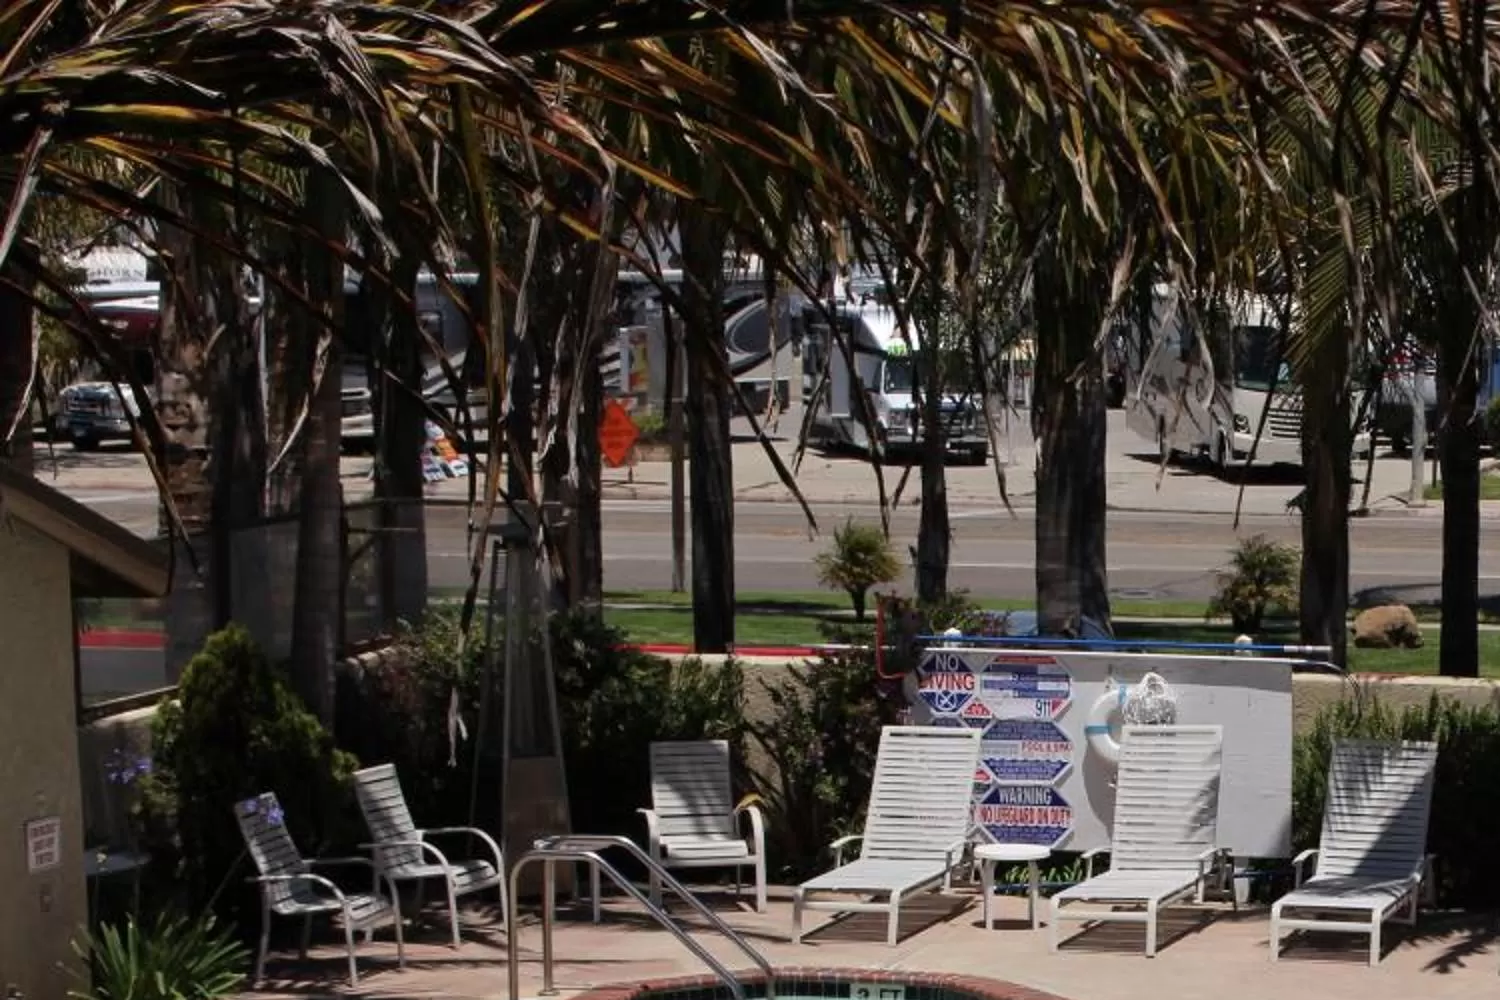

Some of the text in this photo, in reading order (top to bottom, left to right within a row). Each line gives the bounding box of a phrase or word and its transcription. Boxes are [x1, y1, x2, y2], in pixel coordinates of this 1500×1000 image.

[935, 654, 959, 671] NO
[1035, 700, 1051, 717] 911
[999, 787, 1053, 804] WARNING
[981, 807, 1072, 825] NO LIFEGUARD ON DUTY
